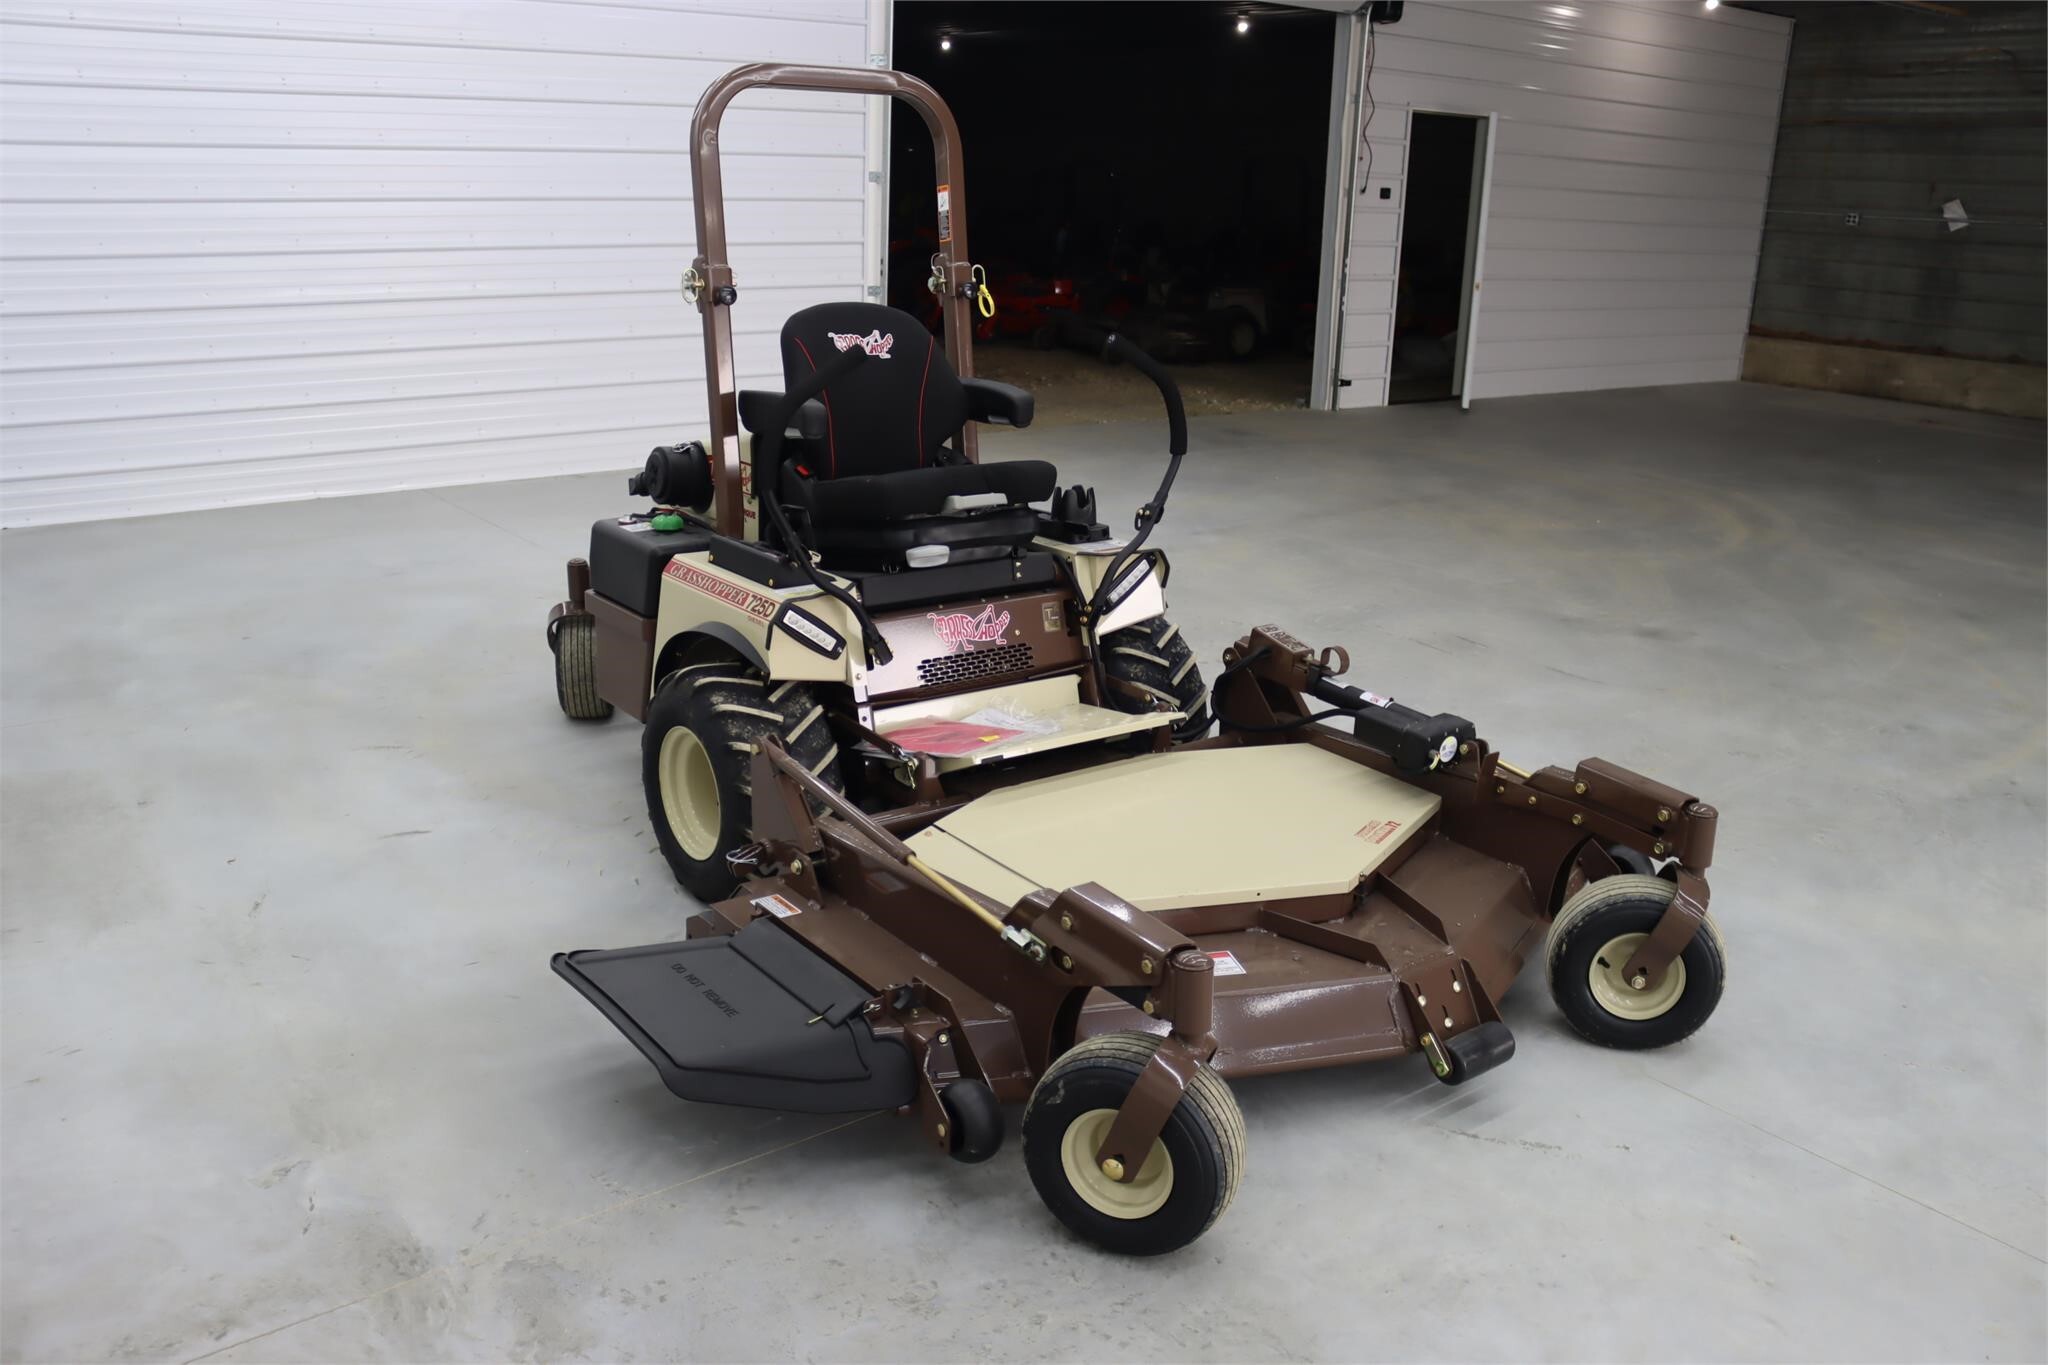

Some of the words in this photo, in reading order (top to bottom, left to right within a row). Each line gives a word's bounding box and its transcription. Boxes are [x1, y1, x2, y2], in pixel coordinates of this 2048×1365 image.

[670, 563, 748, 607] GRASSHOPPER
[747, 594, 776, 618] 725D
[671, 963, 685, 975] DO
[684, 973, 706, 989] NOT
[702, 988, 740, 1018] REMOVE
